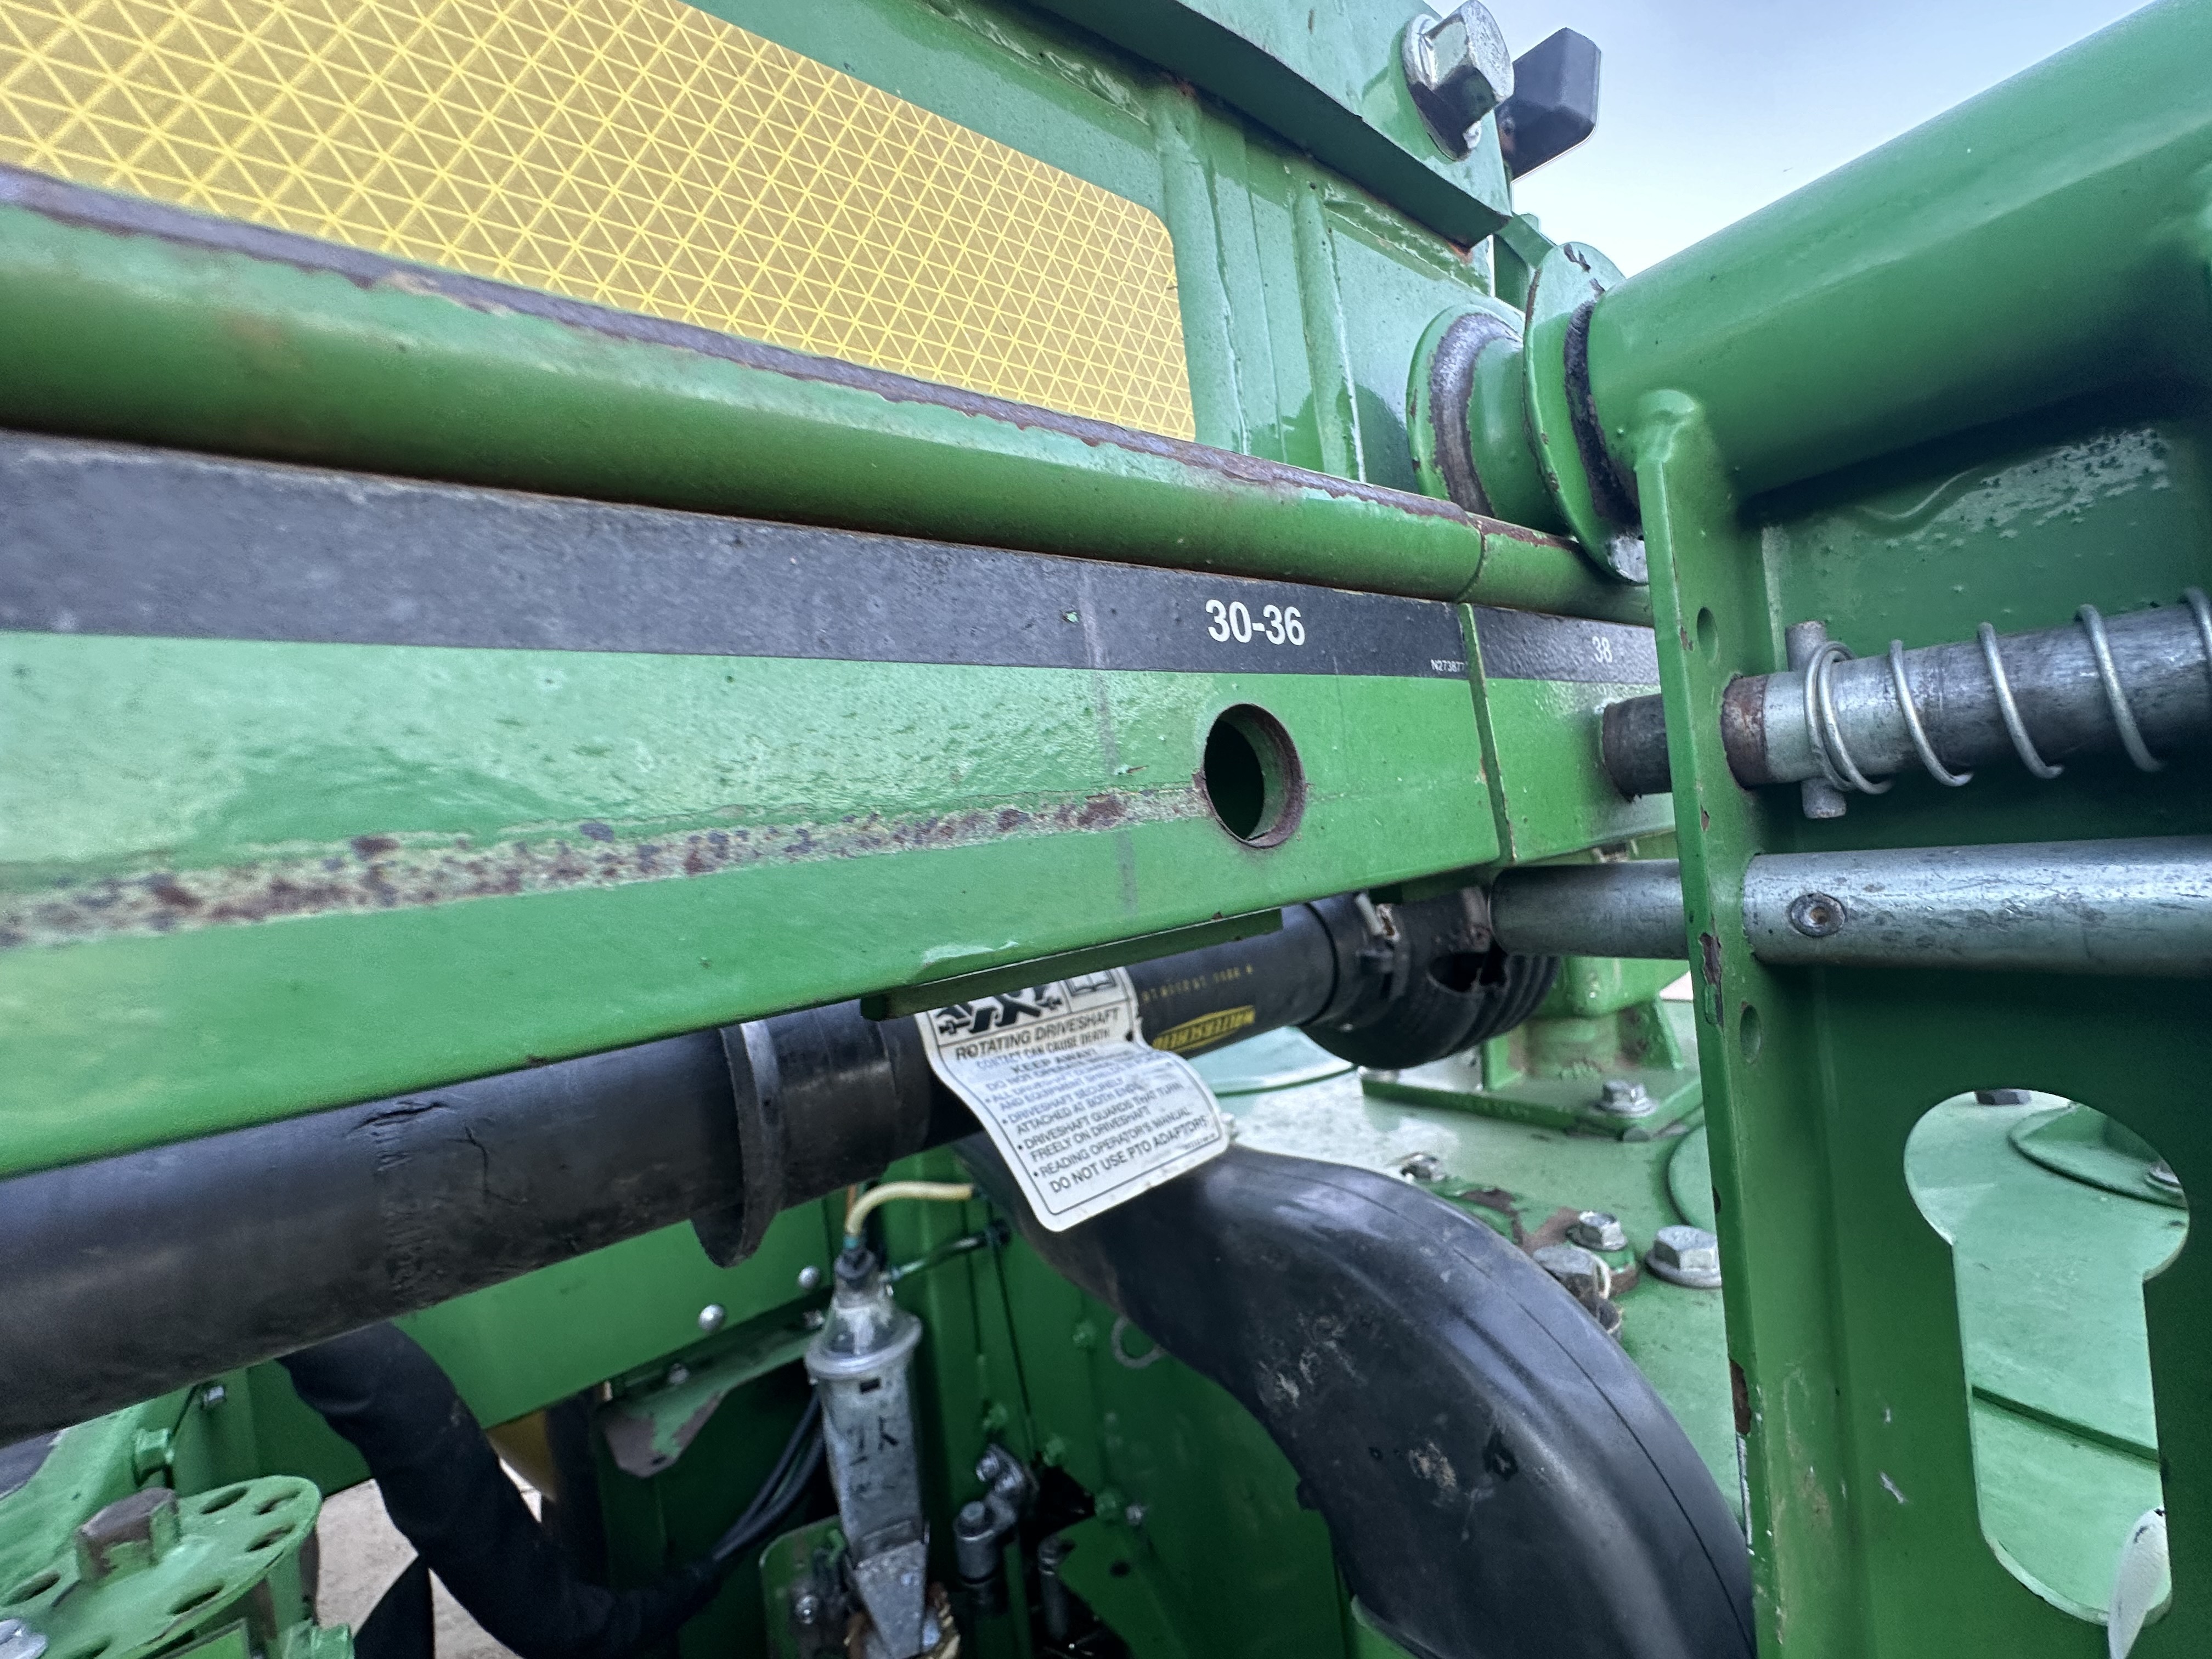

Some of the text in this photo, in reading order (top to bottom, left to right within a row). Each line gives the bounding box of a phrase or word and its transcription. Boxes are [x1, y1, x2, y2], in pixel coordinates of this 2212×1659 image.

[1206, 599, 1305, 646] 30-36
[1592, 636, 1613, 663] 38
[956, 1030, 1032, 1060] ROTATING
[1035, 1007, 1120, 1041] DRIVESHAFT
[1024, 1046, 1044, 1059] CAN
[986, 1080, 1007, 1091] DO
[1011, 1059, 1051, 1073] KEEP
[1000, 1098, 1025, 1111] AND
[1008, 1077, 1124, 1124] DRIVESHAFT SECURELY
[1017, 1107, 1073, 1135] ATTACHED
[1086, 1092, 1115, 1108] BOTH
[1024, 1082, 1184, 1150] DRIVESHAFT GUARDS THAT TURN
[1030, 1105, 1151, 1162] FREELY ON DRIVESHAFT
[1039, 1149, 1091, 1178] READING
[1089, 1121, 1152, 1155] OPERATOR'S
[1151, 1107, 1192, 1128] MANUAL
[1049, 1177, 1071, 1193] DO
[1071, 1163, 1099, 1184] NOT
[1099, 1150, 1128, 1171] USE
[1126, 1140, 1152, 1159] PTO
[1152, 1115, 1209, 1148] ADAPTORS
